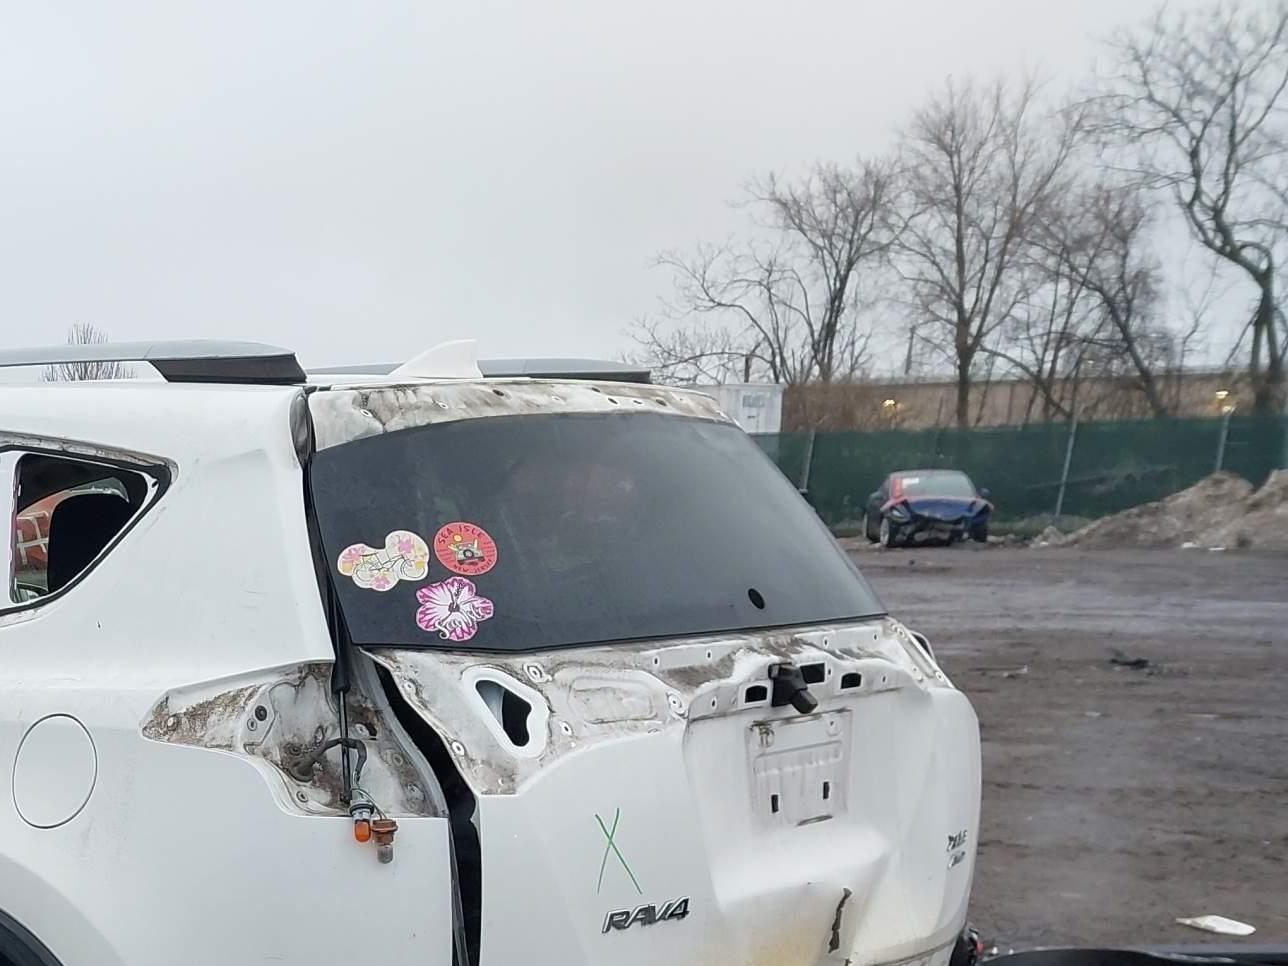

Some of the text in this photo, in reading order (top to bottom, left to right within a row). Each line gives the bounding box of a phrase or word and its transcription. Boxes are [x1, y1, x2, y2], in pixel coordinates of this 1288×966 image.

[438, 524, 485, 545] SEA ISLE
[602, 895, 691, 935] RAV4
